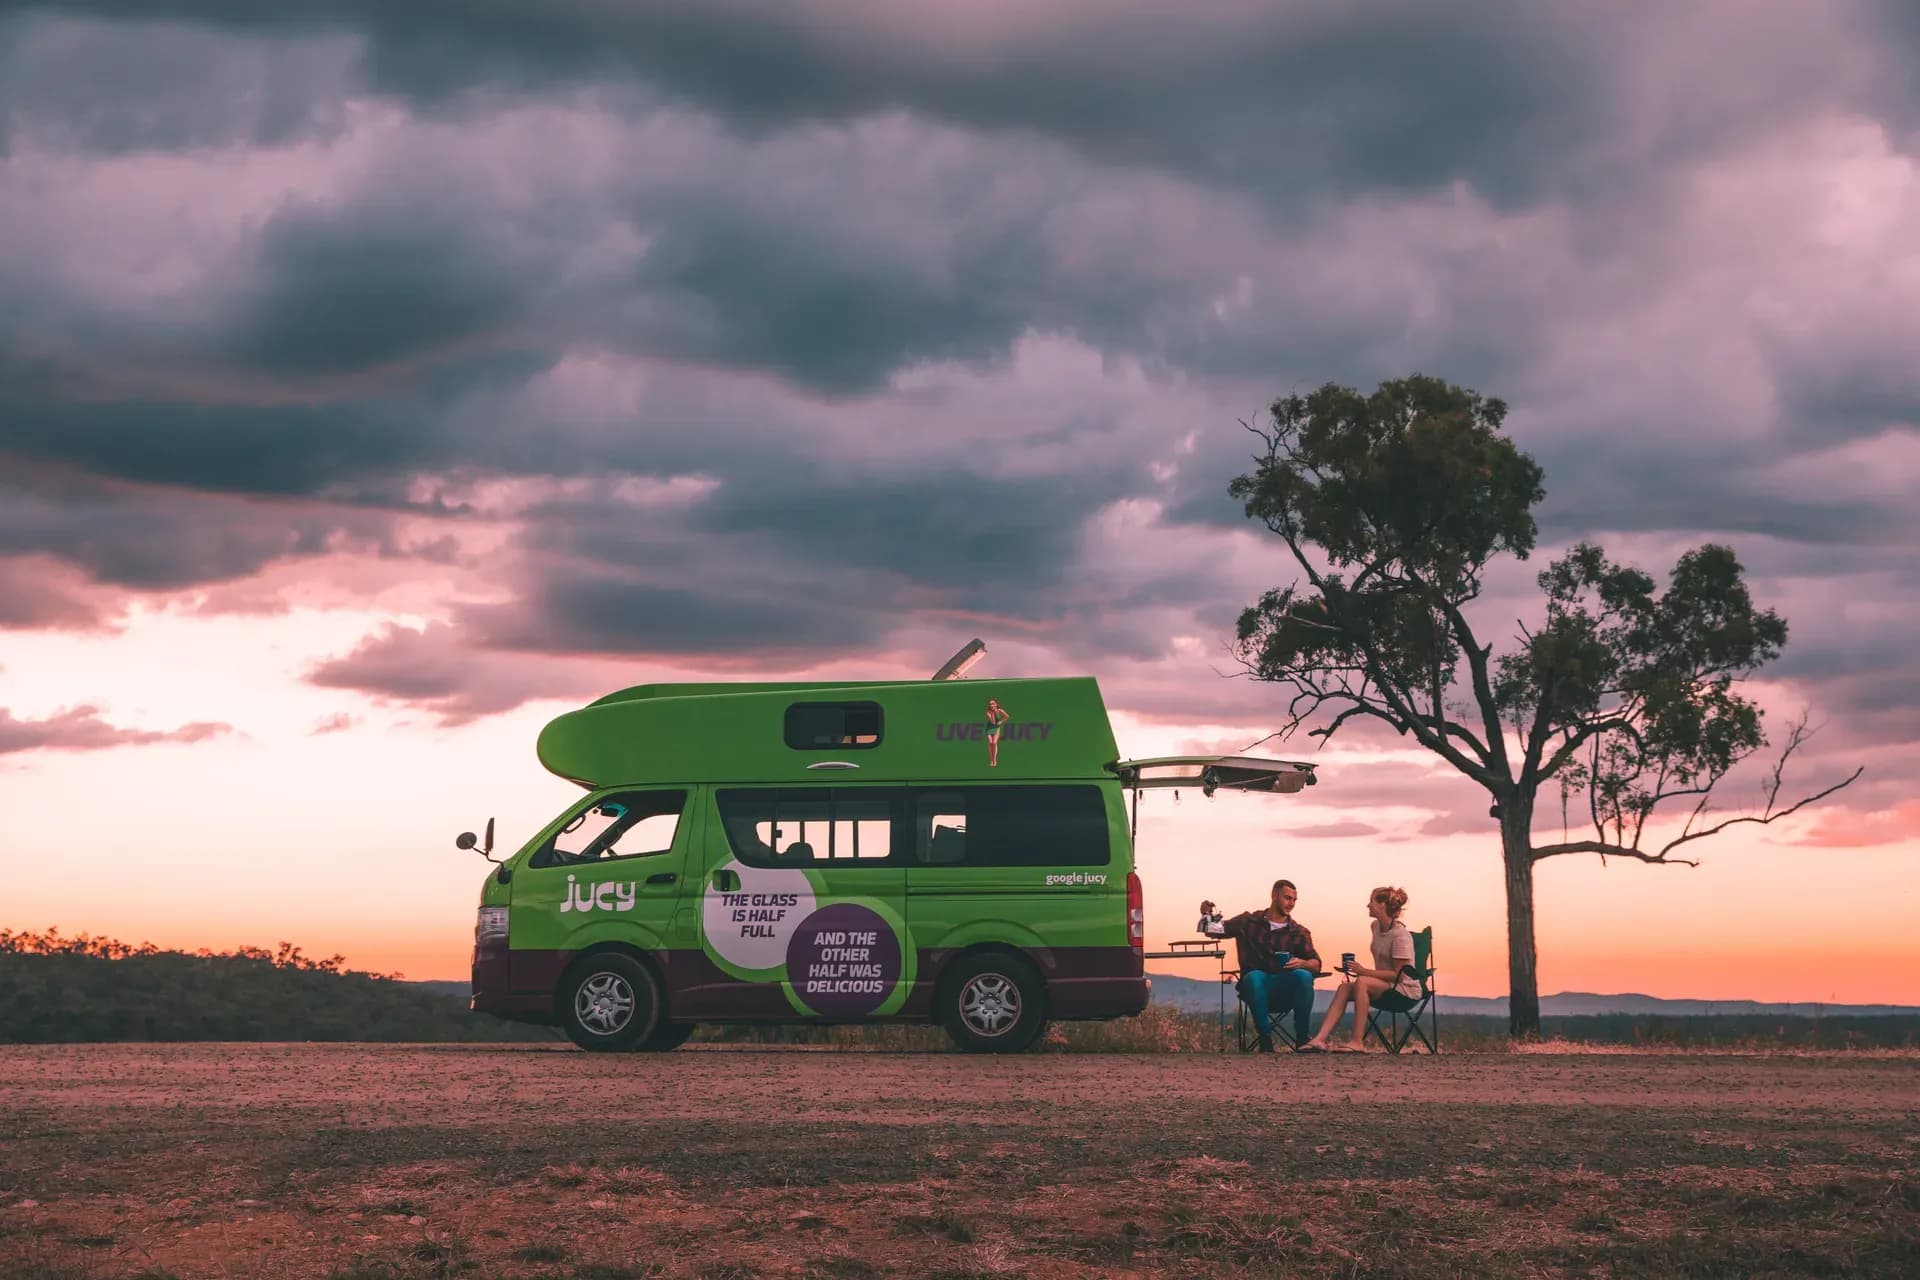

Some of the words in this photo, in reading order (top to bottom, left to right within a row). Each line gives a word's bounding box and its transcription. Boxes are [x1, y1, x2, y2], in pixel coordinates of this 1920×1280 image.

[936, 722, 985, 741] LIVE
[999, 721, 1053, 741] JUCY
[1046, 872, 1082, 885] google
[1083, 872, 1107, 885] jucy
[560, 873, 636, 913] jucy
[722, 894, 749, 906] THE
[751, 894, 798, 906] GLASS
[732, 909, 746, 921] IS
[748, 909, 786, 921] HALF
[740, 925, 775, 938] FULL
[814, 932, 846, 945] AND
[848, 932, 877, 945] THE
[821, 948, 870, 961] OTHER
[809, 964, 847, 977] HALF
[849, 964, 882, 977] WAS
[807, 980, 884, 993] DELICIOUS
